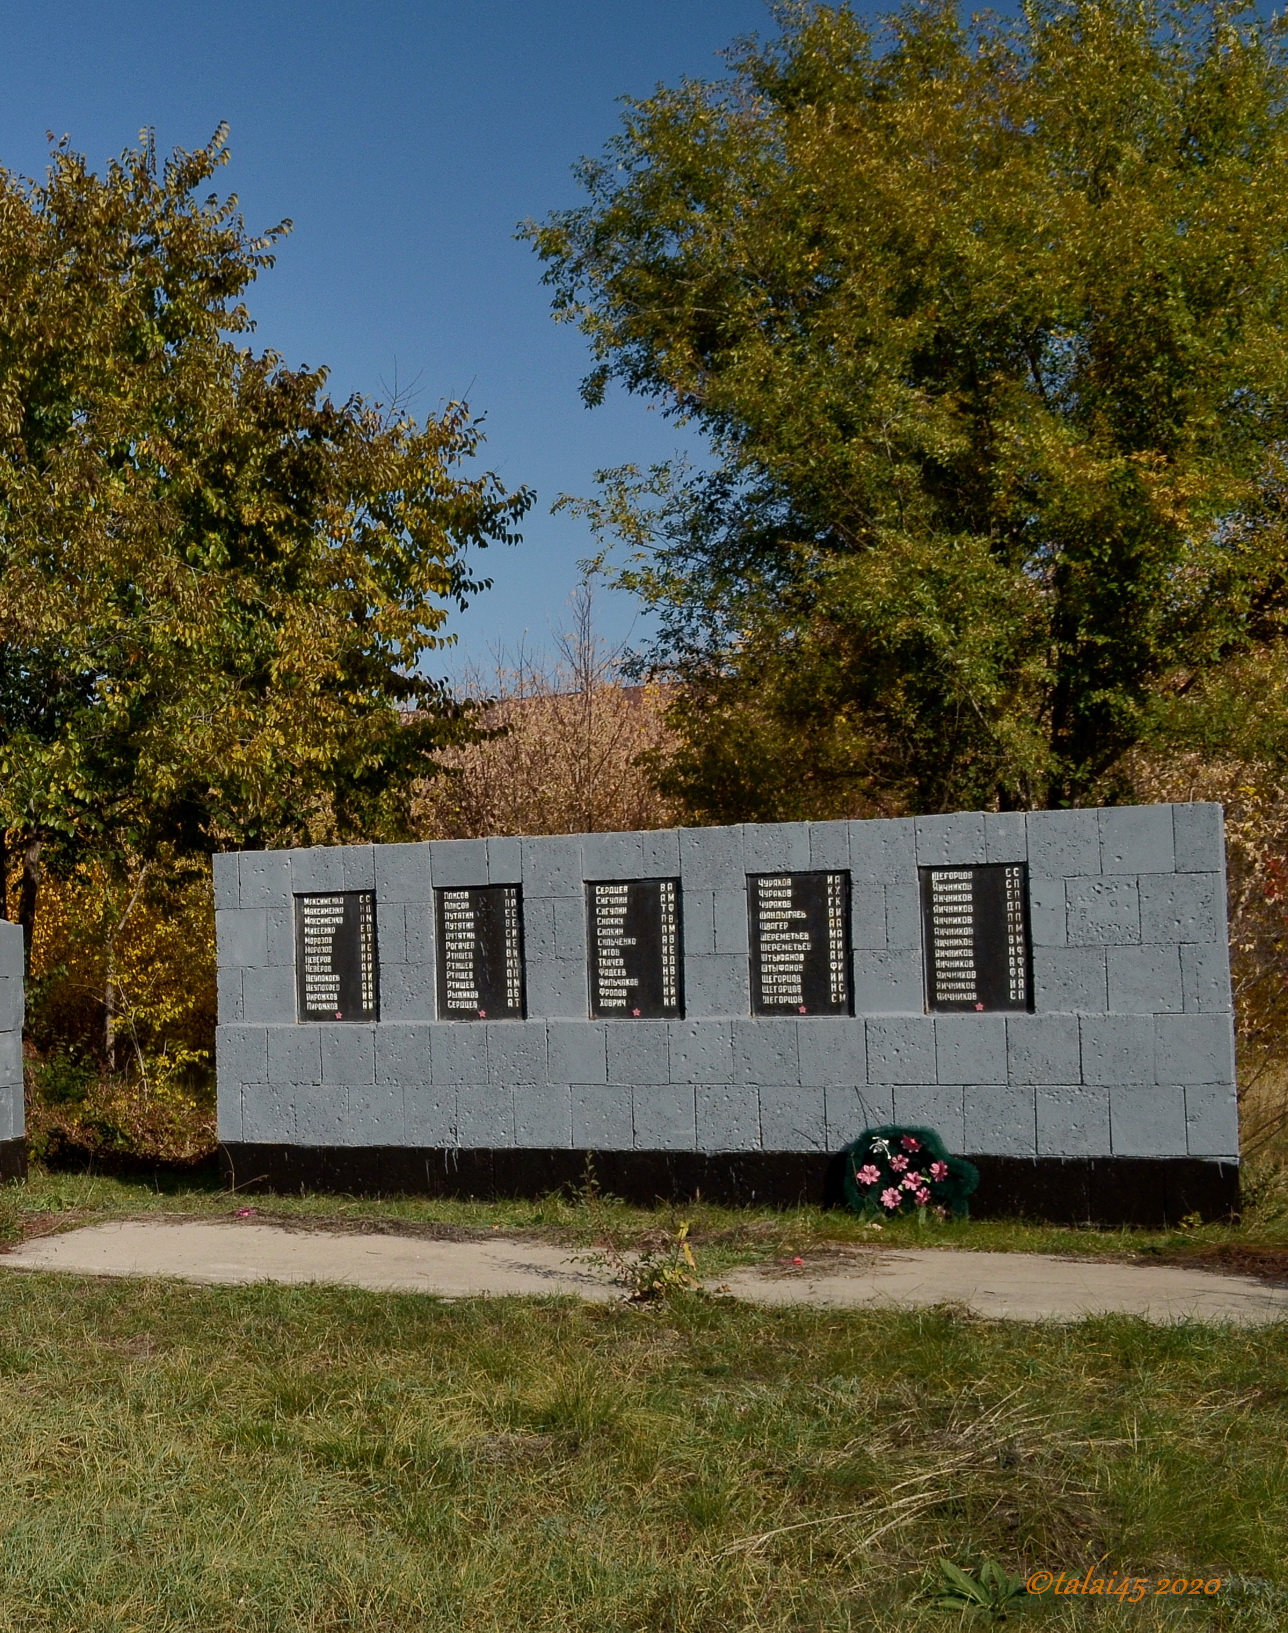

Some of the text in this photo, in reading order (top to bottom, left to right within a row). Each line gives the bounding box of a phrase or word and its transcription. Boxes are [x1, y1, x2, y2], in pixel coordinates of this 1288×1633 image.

[932, 883, 972, 892] ЯИЧНИКОВ
[933, 894, 972, 903] ЯИЧНИКОВ
[933, 904, 973, 913] ЯИЧНИКОВ
[934, 916, 972, 925] ЯИЧНИКОВ
[934, 927, 973, 936] ЯИЧНИКОВ
[305, 937, 332, 945] МОРОЗОВ
[761, 932, 809, 941] ШЕРЕМЕТЬЕВ
[761, 943, 811, 951] ШЕРЕМЕТЬЕВ
[935, 938, 973, 947] ЯИЧНИКОВ
[598, 948, 619, 956] ТИТОВ
[935, 949, 973, 958] ЯИЧНИКОВ
[598, 958, 623, 966] ТКАЧЕВ
[936, 960, 974, 968] ЯИЧНИКОВ
[599, 968, 626, 976] ФАДЕЕВ
[936, 971, 976, 979] ЯИЧНИКОВ
[937, 981, 975, 990] ЯИЧНИКОВ
[937, 992, 976, 1001] ЯИЧНИКОВ
